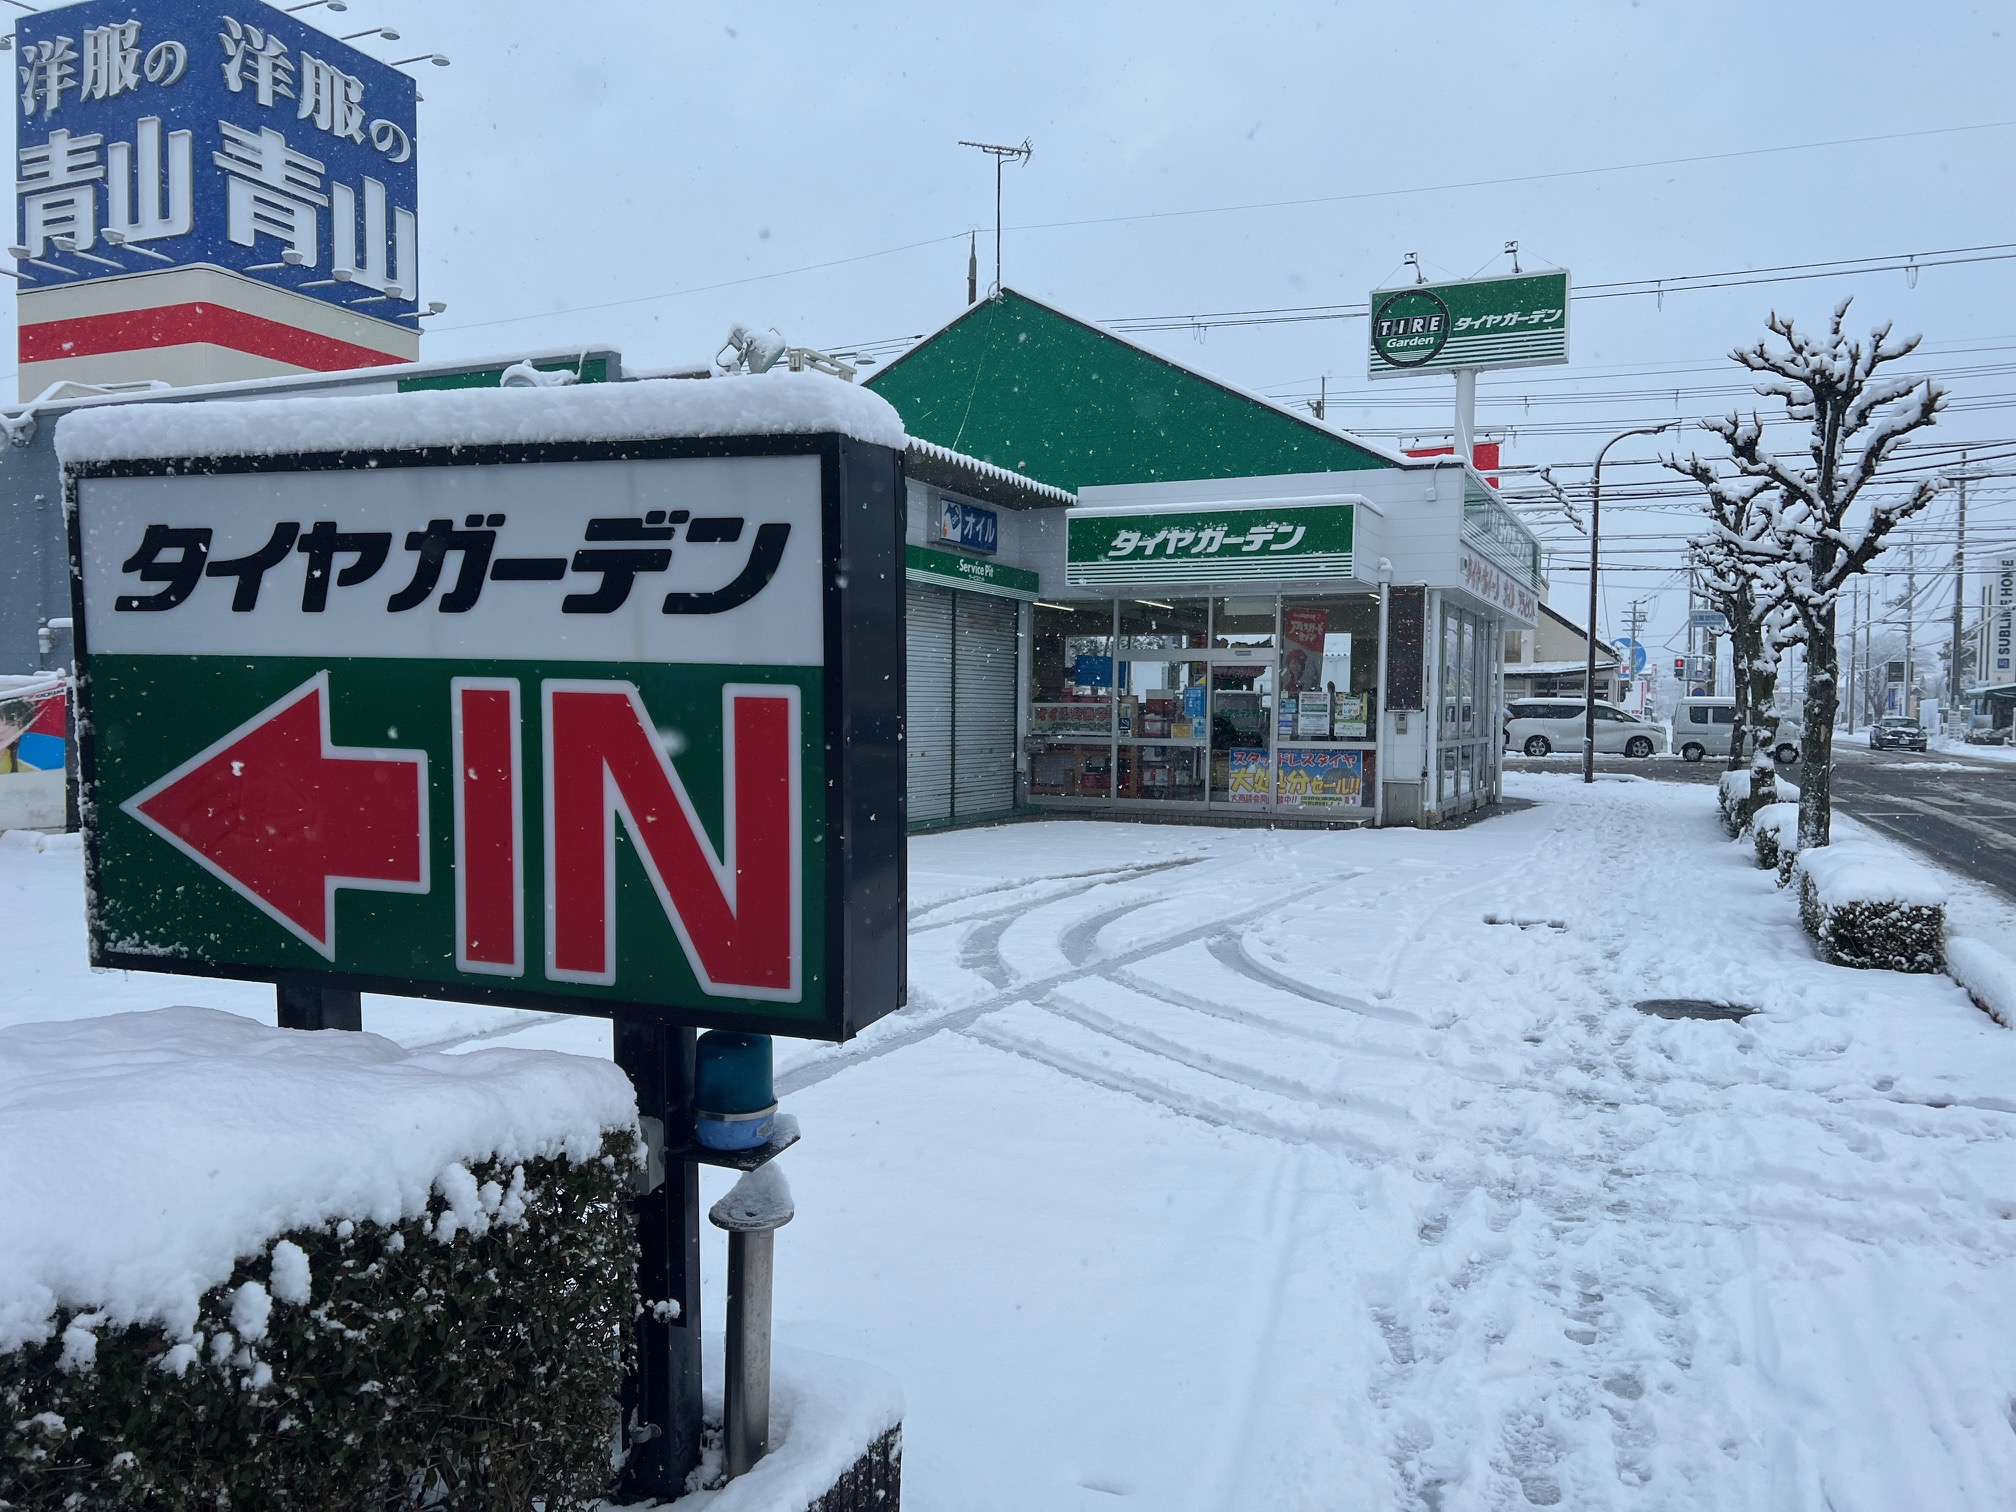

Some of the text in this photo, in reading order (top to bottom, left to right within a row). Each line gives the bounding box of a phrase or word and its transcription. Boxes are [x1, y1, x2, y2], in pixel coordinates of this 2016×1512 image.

[19, 19, 188, 116] 洋服の
[218, 15, 412, 163] 洋服の
[15, 116, 194, 259] 青山
[212, 120, 416, 302] 青山
[1380, 316, 1442, 337] TIRE
[1453, 309, 1563, 331] タイヤガーデン
[1386, 336, 1434, 348] Garden
[964, 513, 995, 543] オイル
[1108, 523, 1306, 556] タイヤガーデン
[114, 509, 793, 615] タイヤガーデン
[959, 559, 984, 575] Service
[985, 564, 994, 578] Pit
[2000, 560, 2014, 596] HOME
[1233, 751, 1358, 768] スタッドレスタイヤ
[452, 677, 803, 1001] IN
